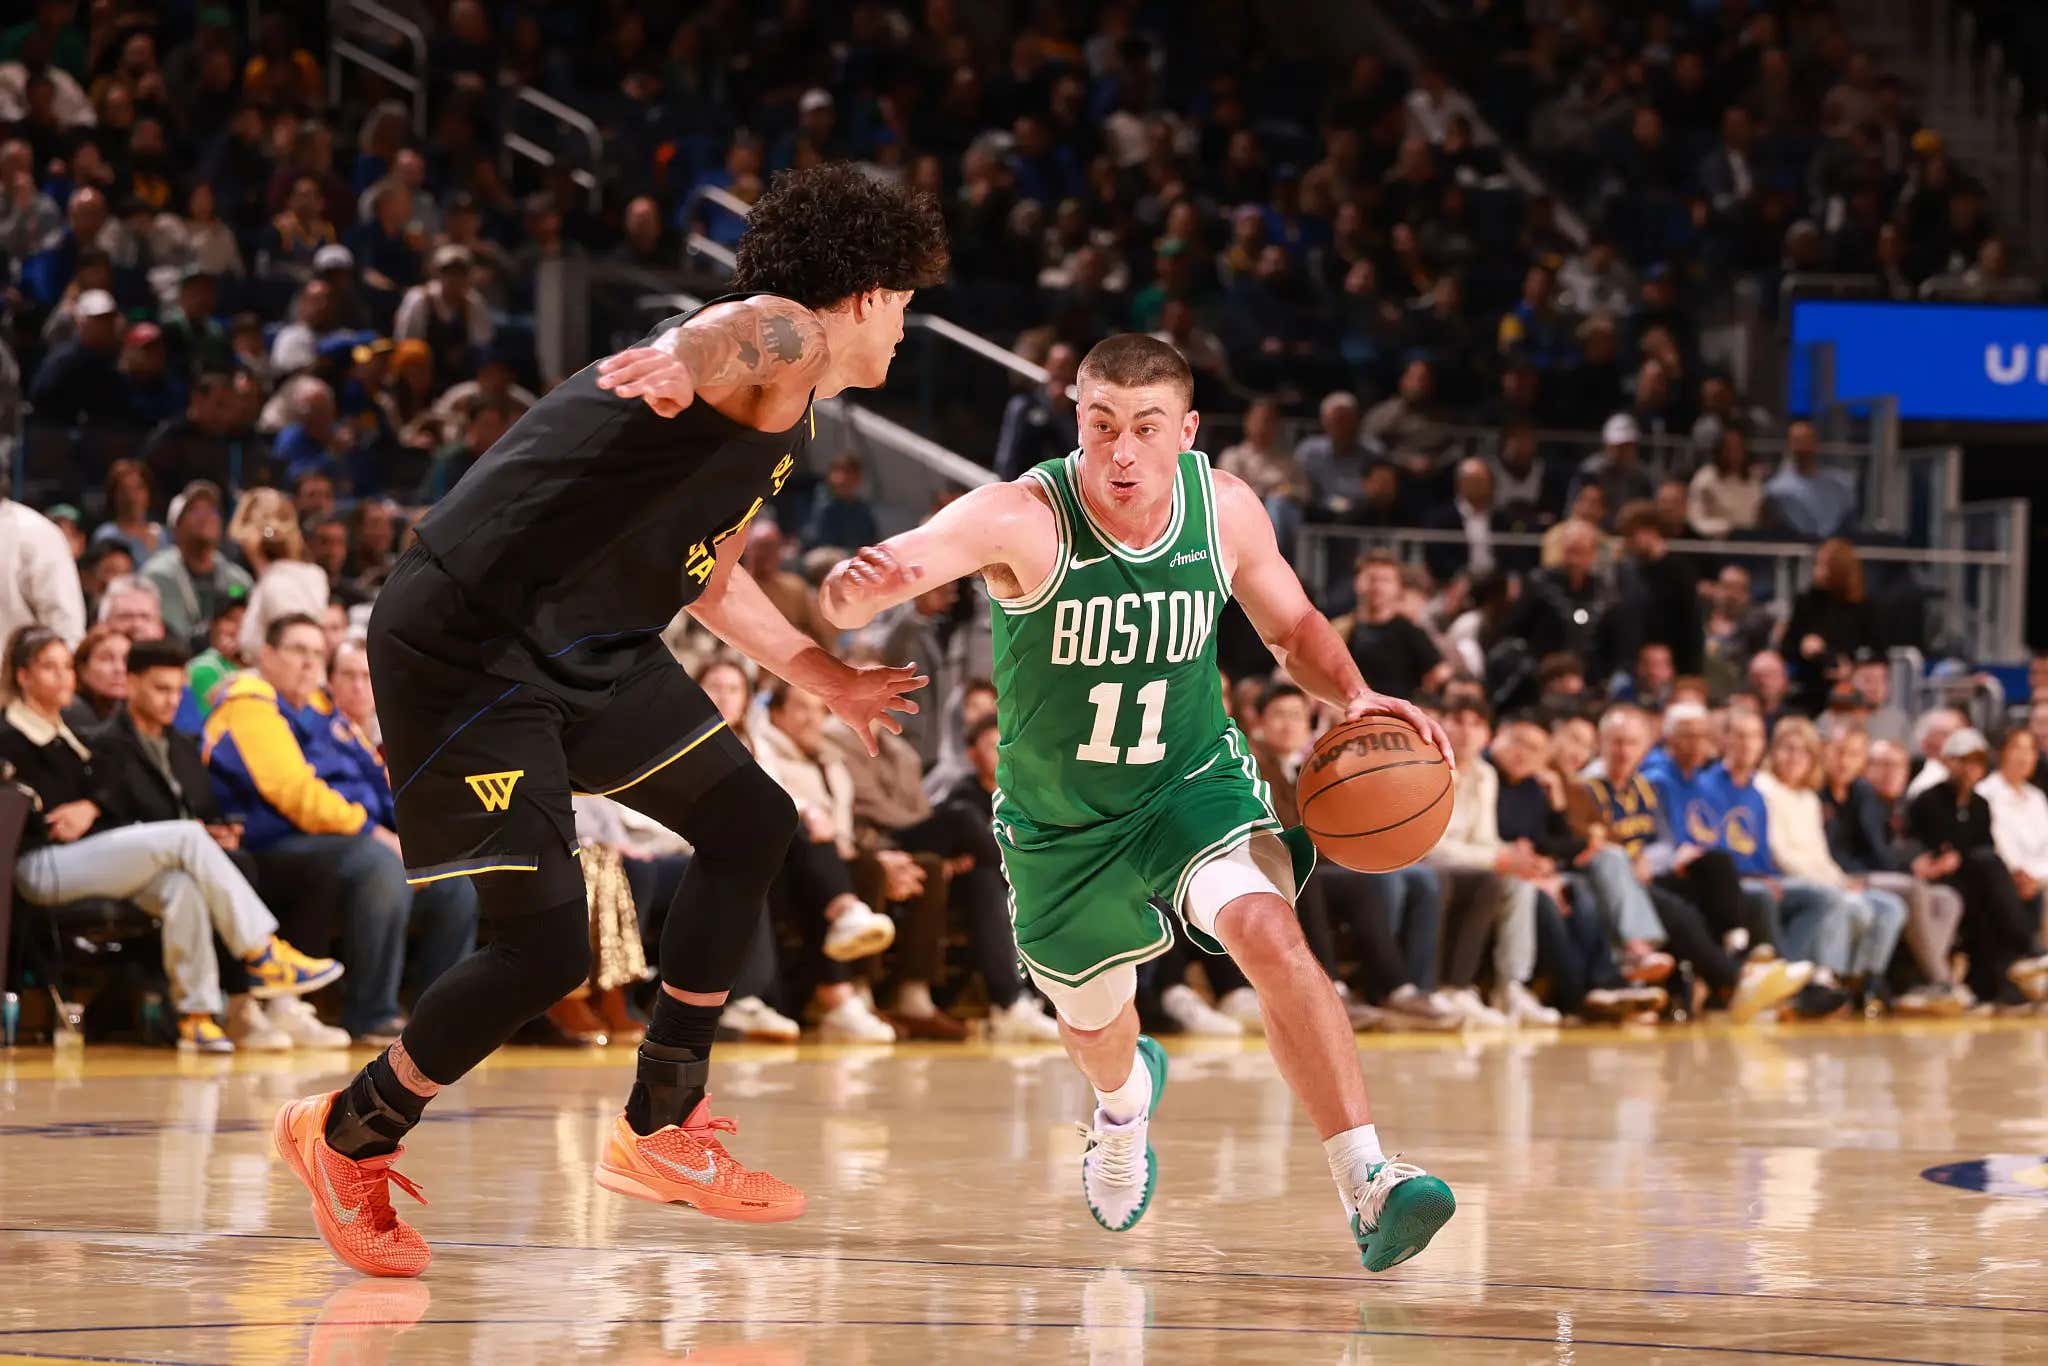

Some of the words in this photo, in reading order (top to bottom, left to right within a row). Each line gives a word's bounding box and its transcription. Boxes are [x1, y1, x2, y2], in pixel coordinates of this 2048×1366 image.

[1169, 548, 1208, 568] Amica
[1051, 590, 1215, 667] BOSTON
[1076, 679, 1168, 765] 11
